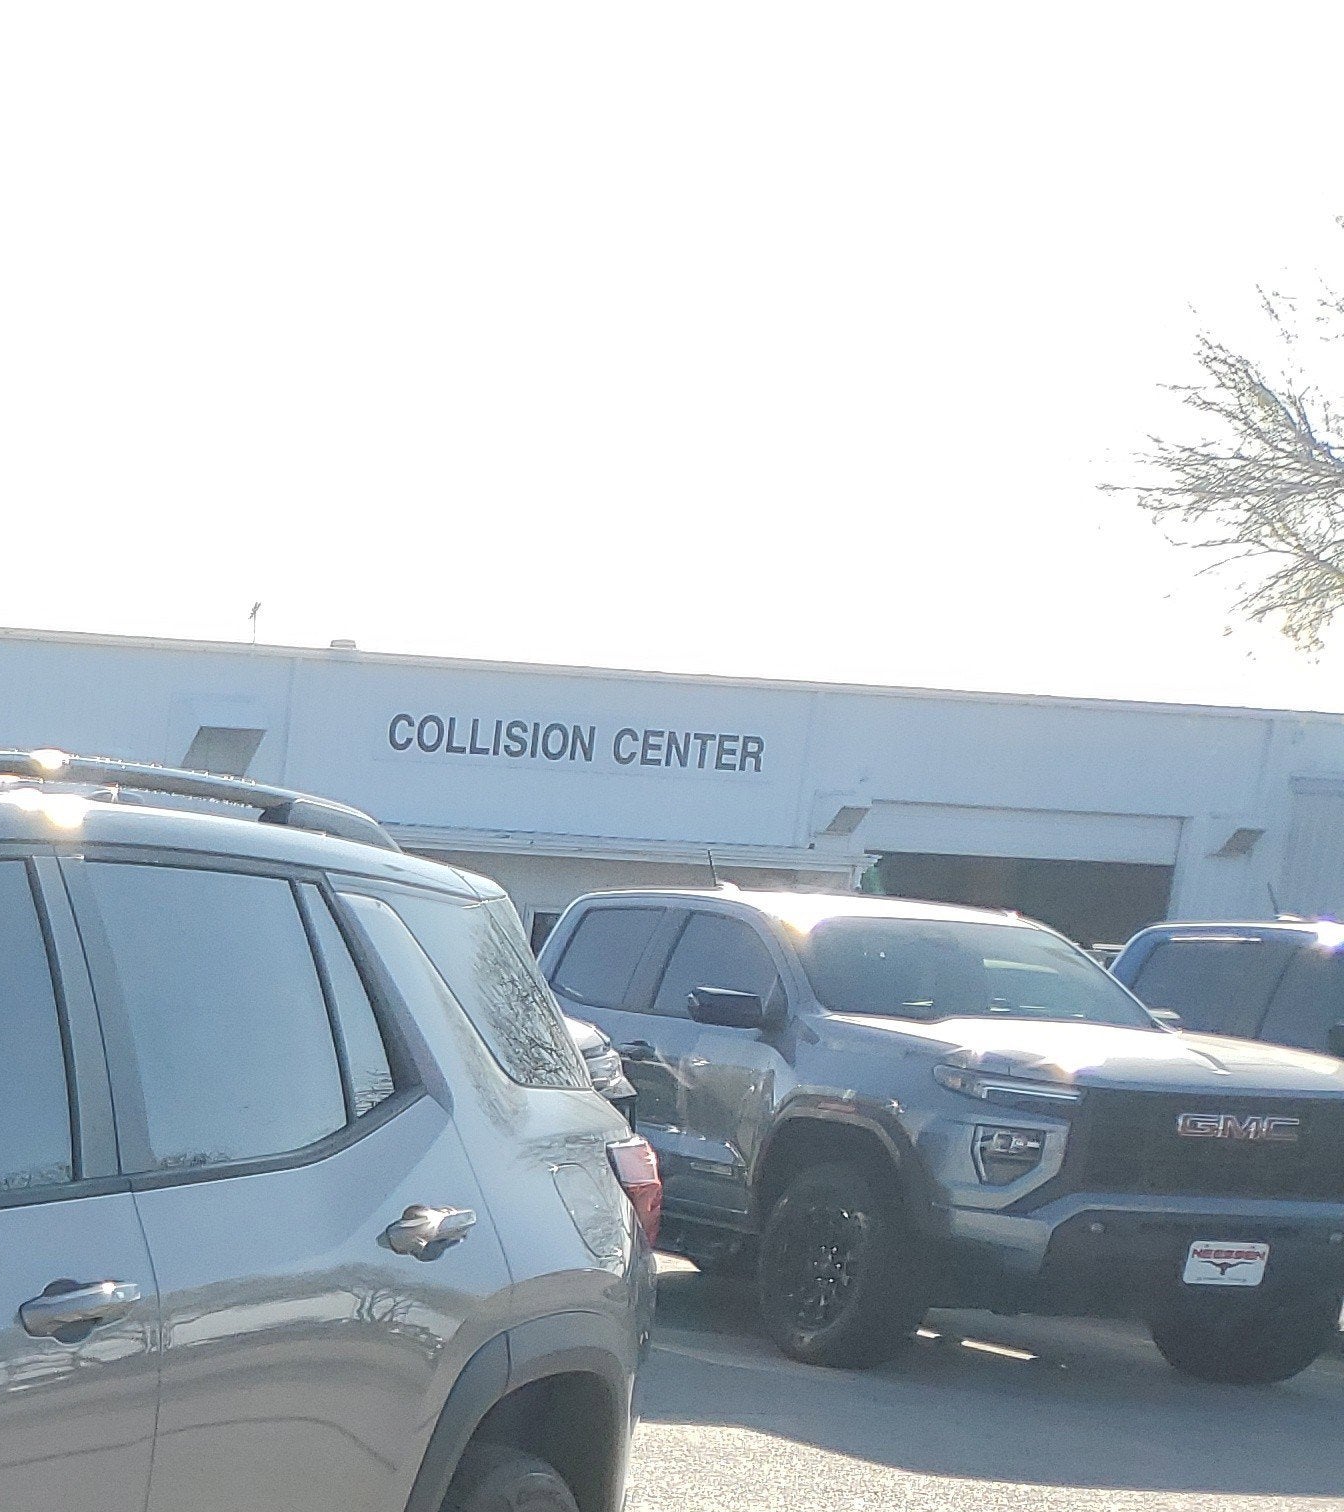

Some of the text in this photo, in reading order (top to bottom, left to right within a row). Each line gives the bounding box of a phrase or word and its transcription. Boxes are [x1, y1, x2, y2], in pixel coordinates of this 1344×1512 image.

[388, 713, 765, 773] COLLISION CENTER
[1177, 1113, 1300, 1141] GMC
